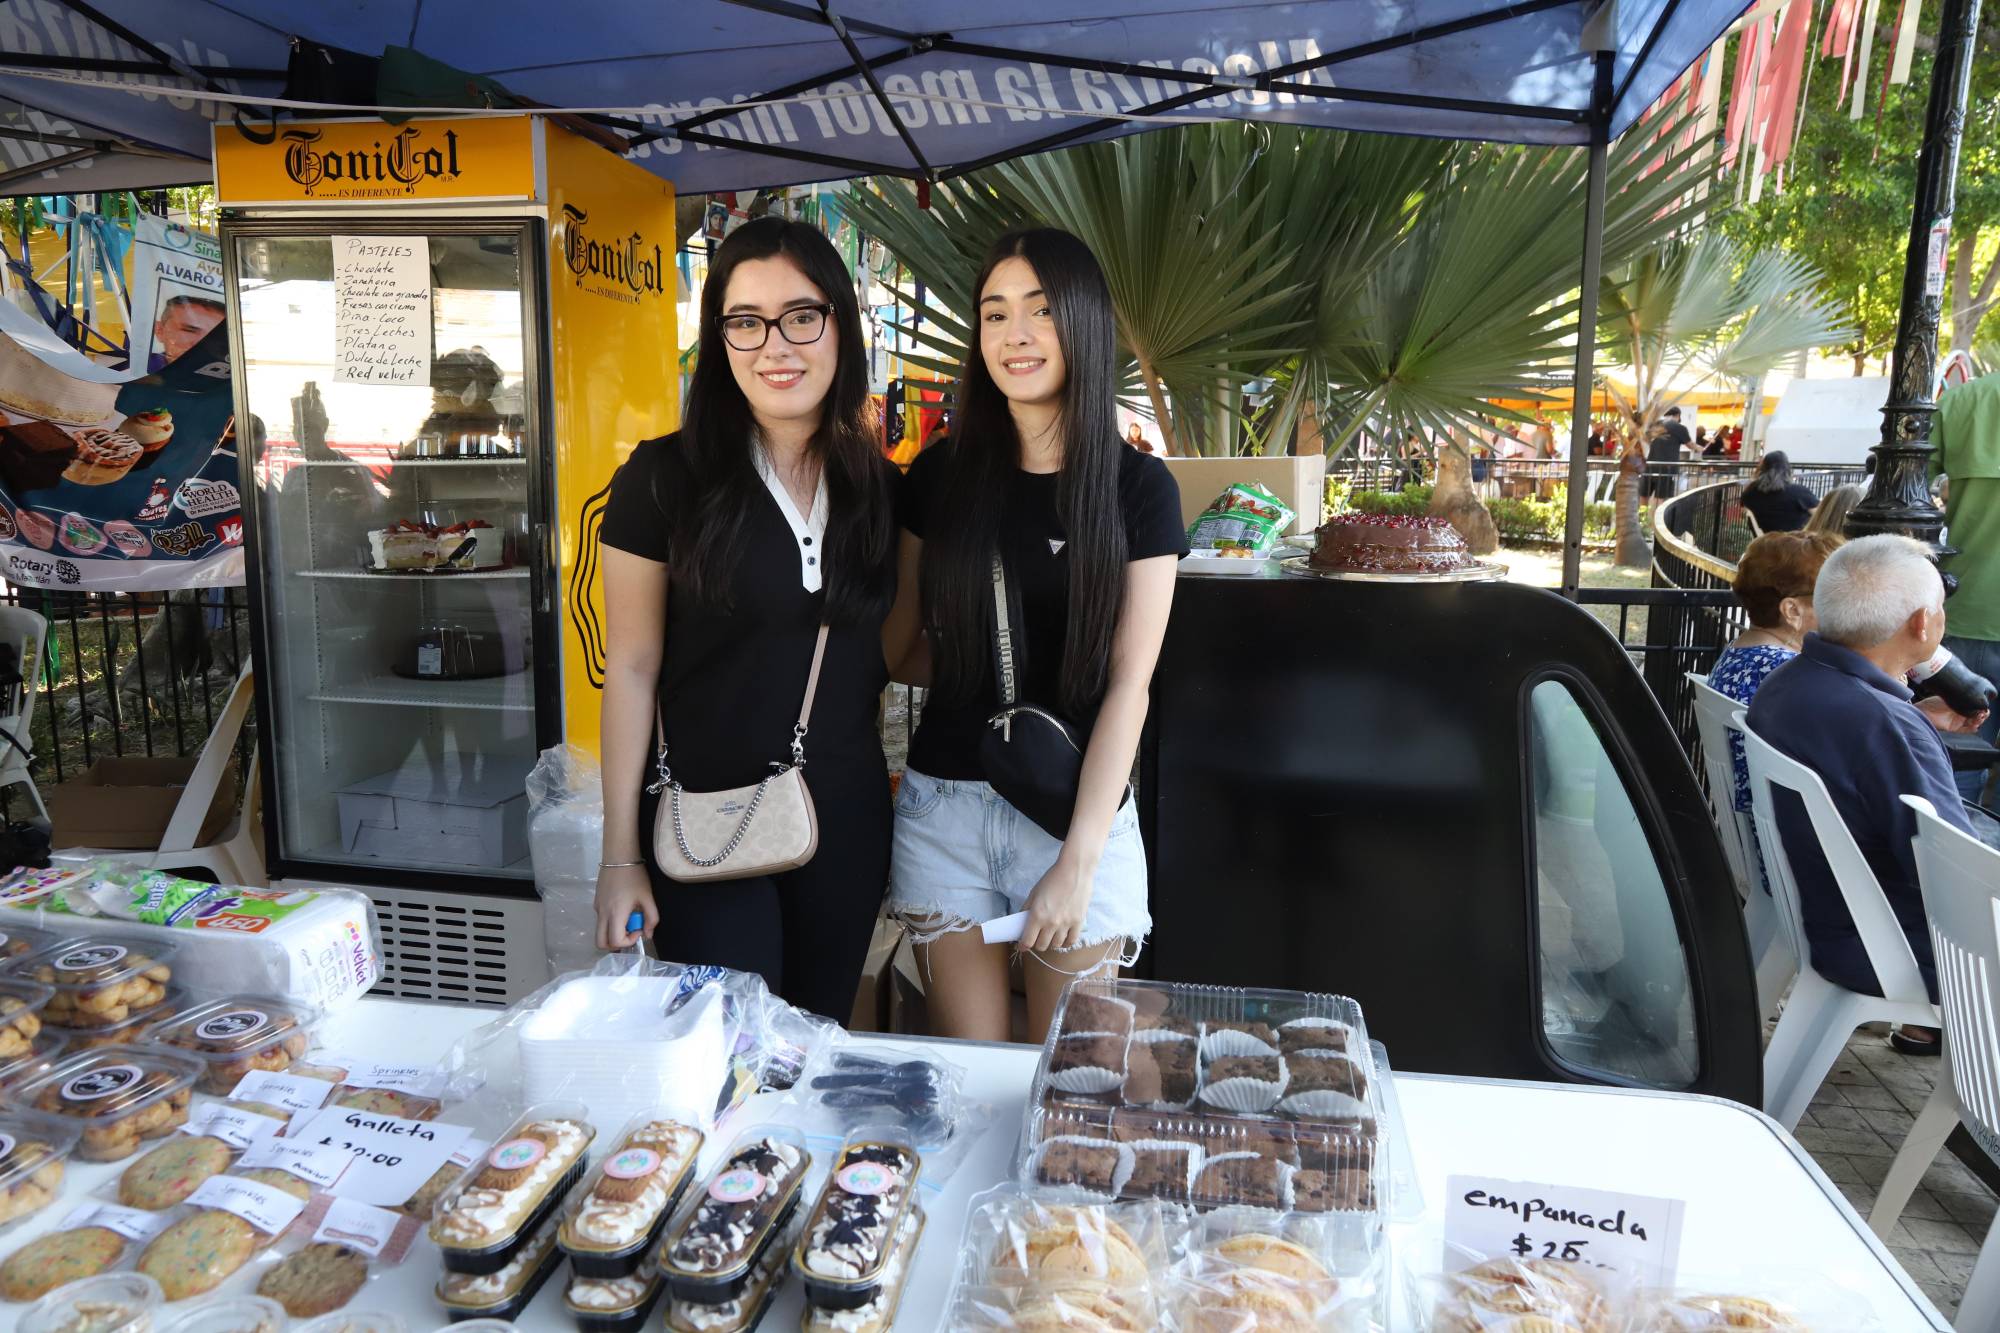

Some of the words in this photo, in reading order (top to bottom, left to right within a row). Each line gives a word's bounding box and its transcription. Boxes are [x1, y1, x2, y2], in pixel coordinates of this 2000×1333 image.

[281, 127, 463, 197] ToniCol
[351, 188, 402, 197] DIFERENTE
[346, 238, 413, 257] PASTELES
[561, 203, 664, 304] ToniCol
[155, 262, 214, 286] ALVARO
[344, 260, 395, 274] Chocolate
[341, 286, 380, 297] Chocolate
[395, 288, 428, 302] granada
[342, 297, 373, 310] Fresas
[343, 323, 370, 335] Tres
[373, 324, 415, 338] Leches
[344, 350, 374, 363] Dulce
[390, 353, 422, 368] Leche
[346, 366, 374, 380] Red
[378, 367, 415, 380] velvet
[186, 484, 227, 499] WORLD
[188, 489, 234, 507] HEALTH
[9, 556, 54, 575] Rotary
[353, 941, 368, 988] Velvet
[345, 1113, 435, 1141] Galleta
[1463, 1189, 1648, 1242] empanada
[1509, 1232, 1534, 1258] $
[1542, 1239, 1618, 1271] 25.
